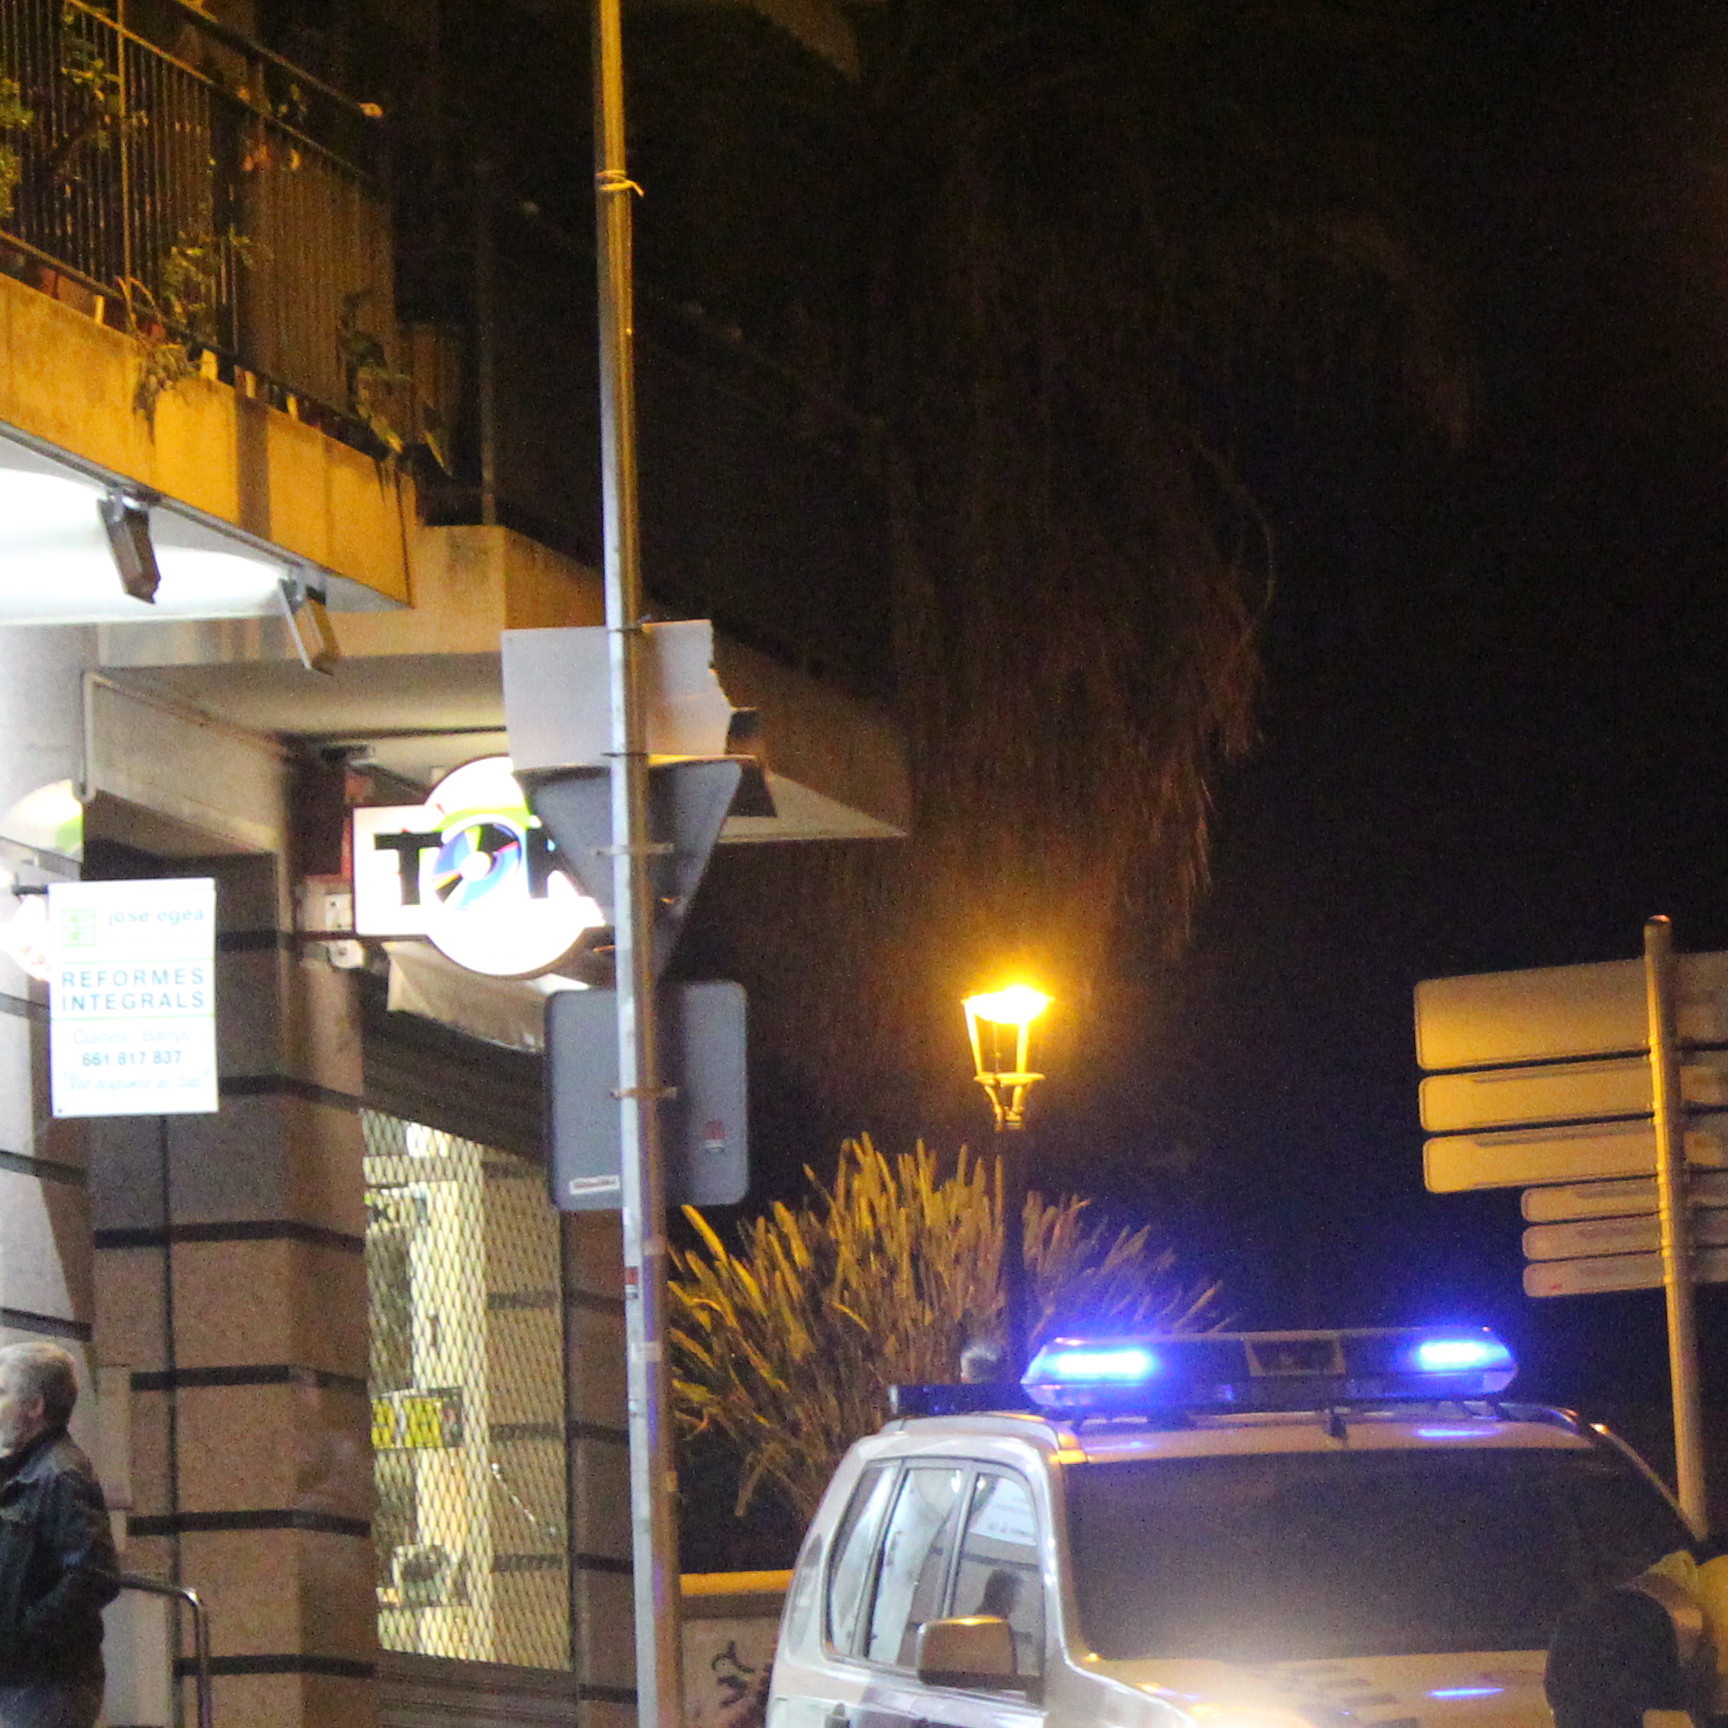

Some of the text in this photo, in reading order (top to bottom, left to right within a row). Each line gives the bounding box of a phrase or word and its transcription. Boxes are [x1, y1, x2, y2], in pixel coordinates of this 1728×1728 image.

[157, 909, 205, 926] egea
[60, 967, 205, 989] REFORMES
[61, 990, 205, 1012] INTEGRALS
[81, 1049, 183, 1068] 661 817 837
